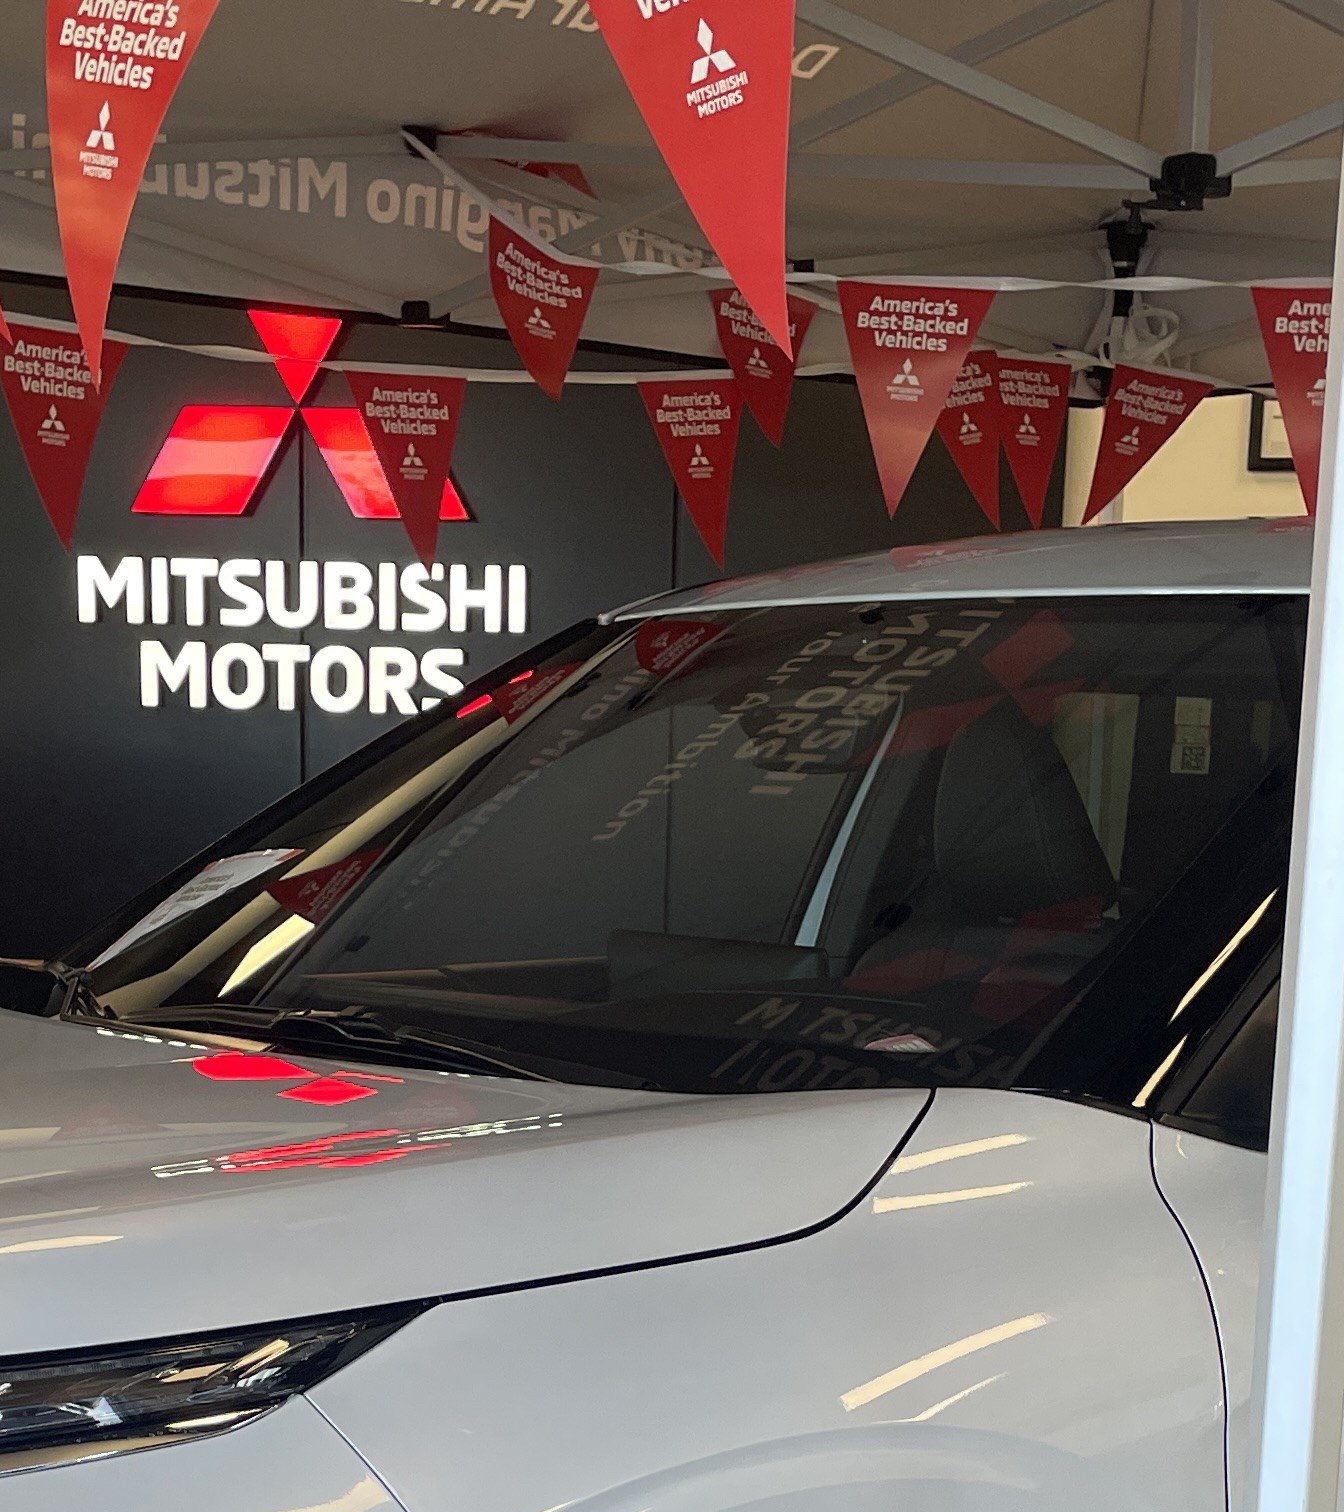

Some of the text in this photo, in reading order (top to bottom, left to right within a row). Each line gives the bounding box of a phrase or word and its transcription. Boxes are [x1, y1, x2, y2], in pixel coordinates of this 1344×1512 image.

[78, 0, 180, 28] America's
[75, 51, 154, 90] Vehicles
[686, 71, 749, 107] MITSUBISHI
[697, 89, 744, 118] MOTORS
[504, 242, 569, 284] America's
[506, 275, 567, 308] Vehicles
[870, 295, 958, 317] America's
[874, 330, 947, 352] Vehicles
[20, 375, 85, 400] Vehicles
[373, 387, 438, 404] America's
[662, 391, 721, 407] America's
[381, 419, 436, 435] Vehicles
[670, 422, 721, 437] Vehicles
[75, 553, 529, 634] MITSUBISHI
[138, 640, 467, 715] MOTORS
